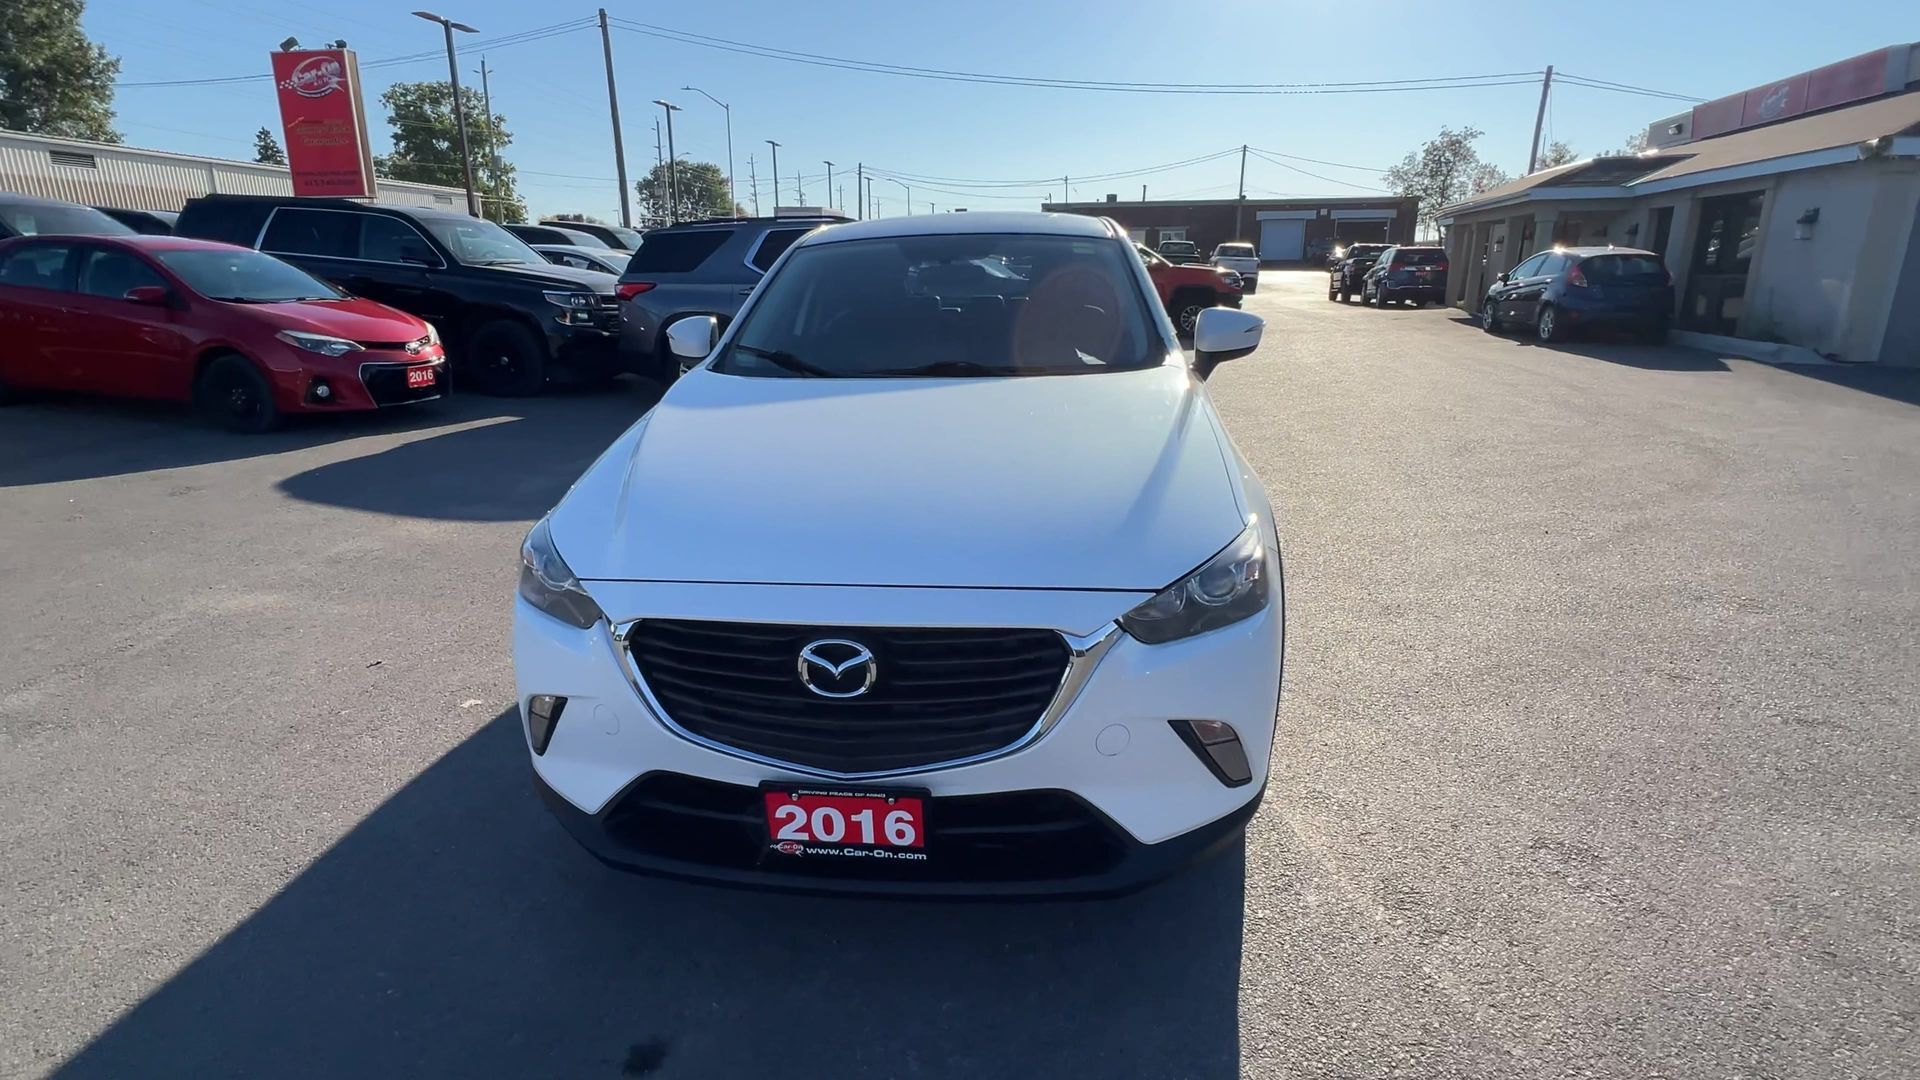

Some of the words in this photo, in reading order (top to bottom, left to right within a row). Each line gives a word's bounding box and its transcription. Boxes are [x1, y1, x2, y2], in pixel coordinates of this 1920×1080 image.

[410, 369, 433, 382] 2016
[774, 804, 916, 847] 2016
[806, 848, 928, 860] www.Car-On.com
